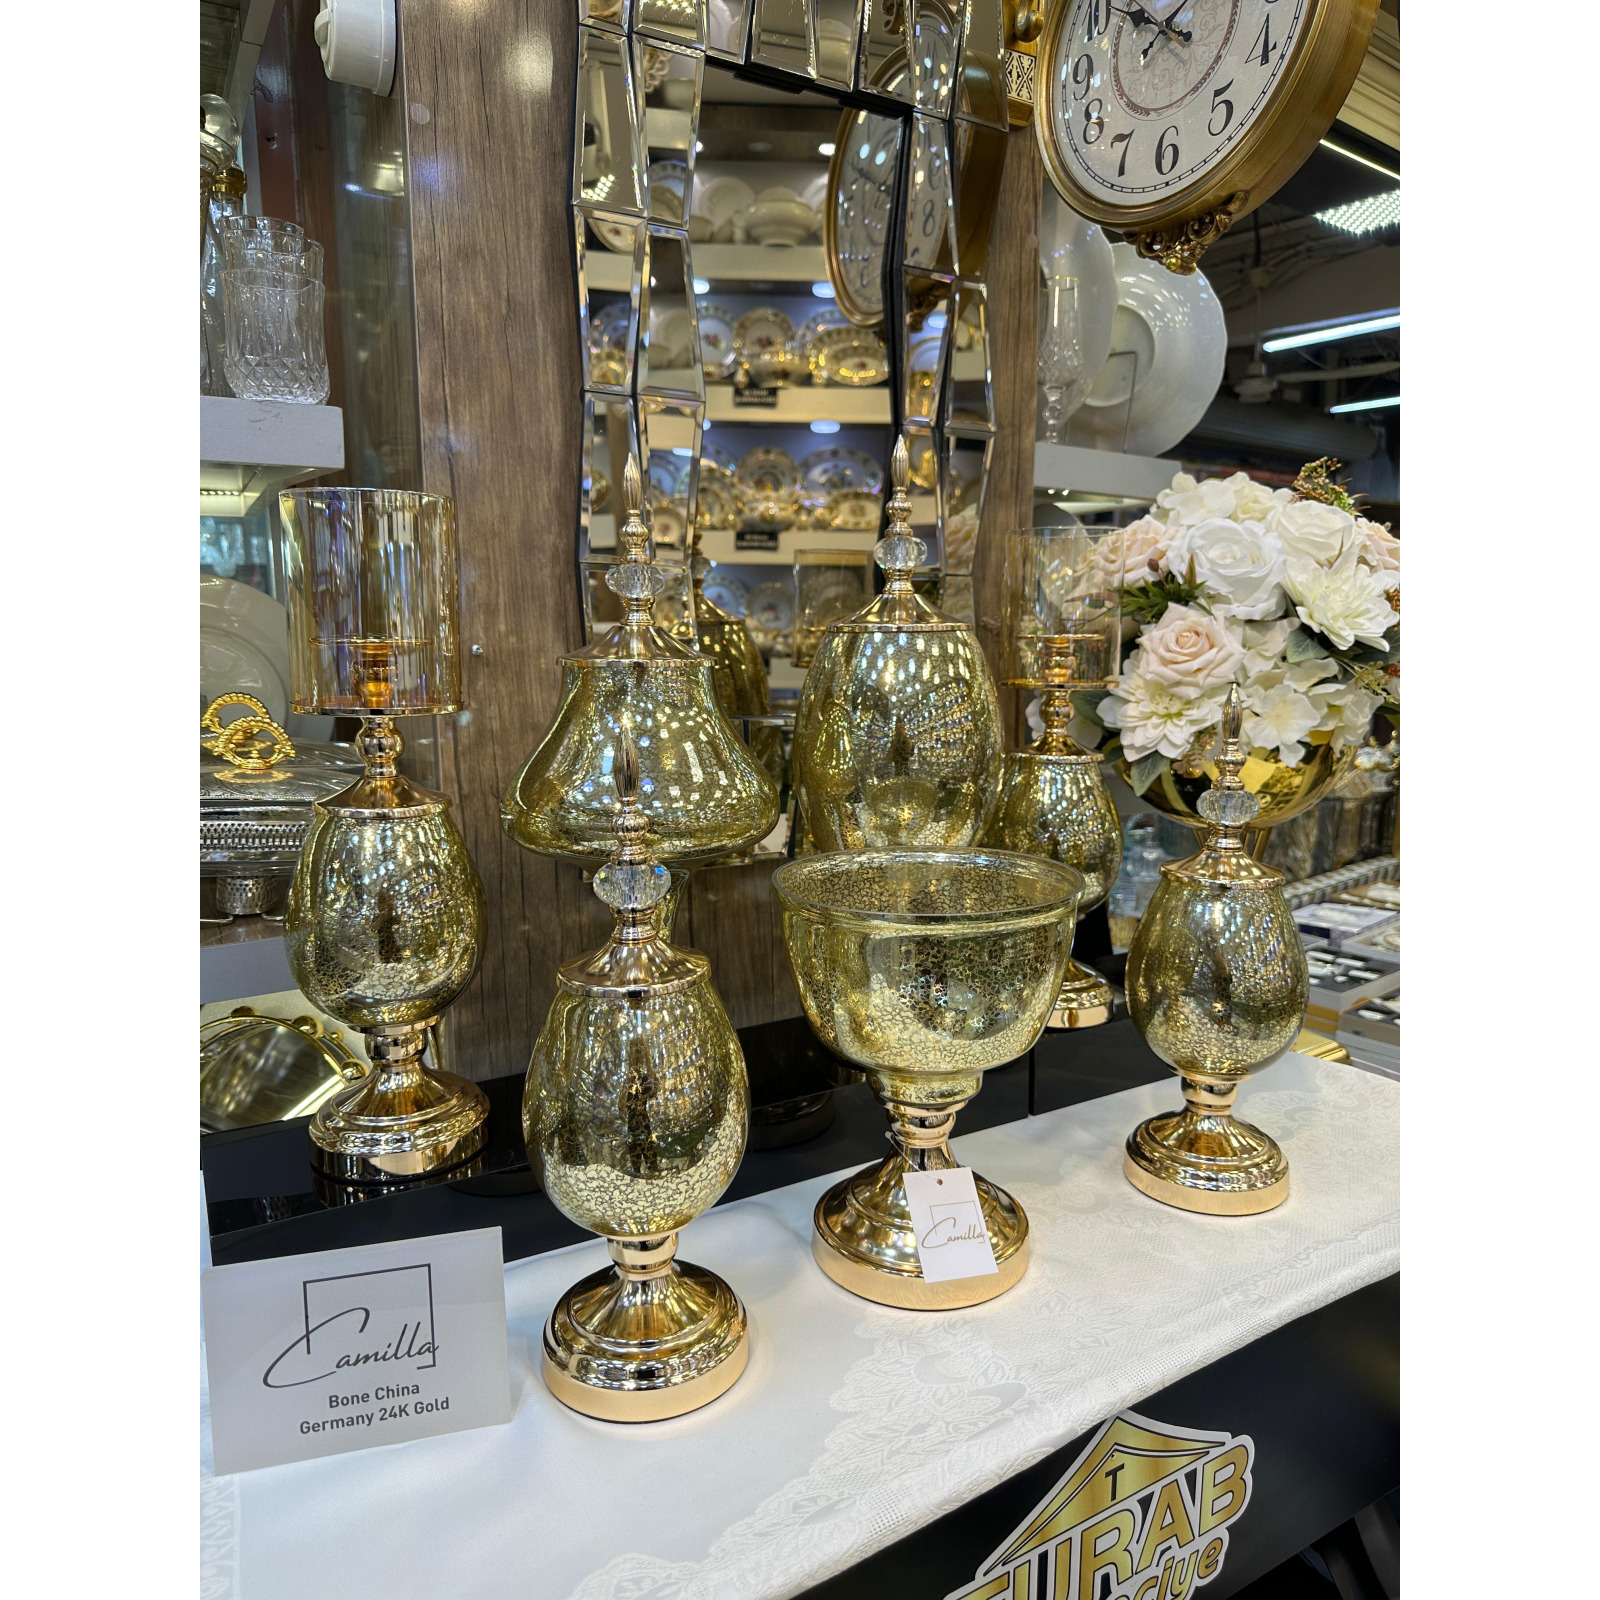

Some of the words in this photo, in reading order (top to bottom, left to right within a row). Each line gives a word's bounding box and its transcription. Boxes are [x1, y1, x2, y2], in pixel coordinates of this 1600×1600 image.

[1244, 12, 1278, 67] 4
[1072, 53, 1095, 101] 9
[1082, 97, 1105, 145] 8
[1207, 78, 1235, 137] 5
[1109, 127, 1136, 178] 7
[1154, 125, 1180, 176] 6
[921, 1216, 985, 1249] Camilla
[262, 1306, 440, 1388] Camilla
[300, 1412, 374, 1434] Germany
[379, 1404, 410, 1422] 24K
[413, 1396, 450, 1416] Gold
[329, 1391, 370, 1409] Bone
[374, 1382, 421, 1401] China
[1104, 1462, 1125, 1503] T
